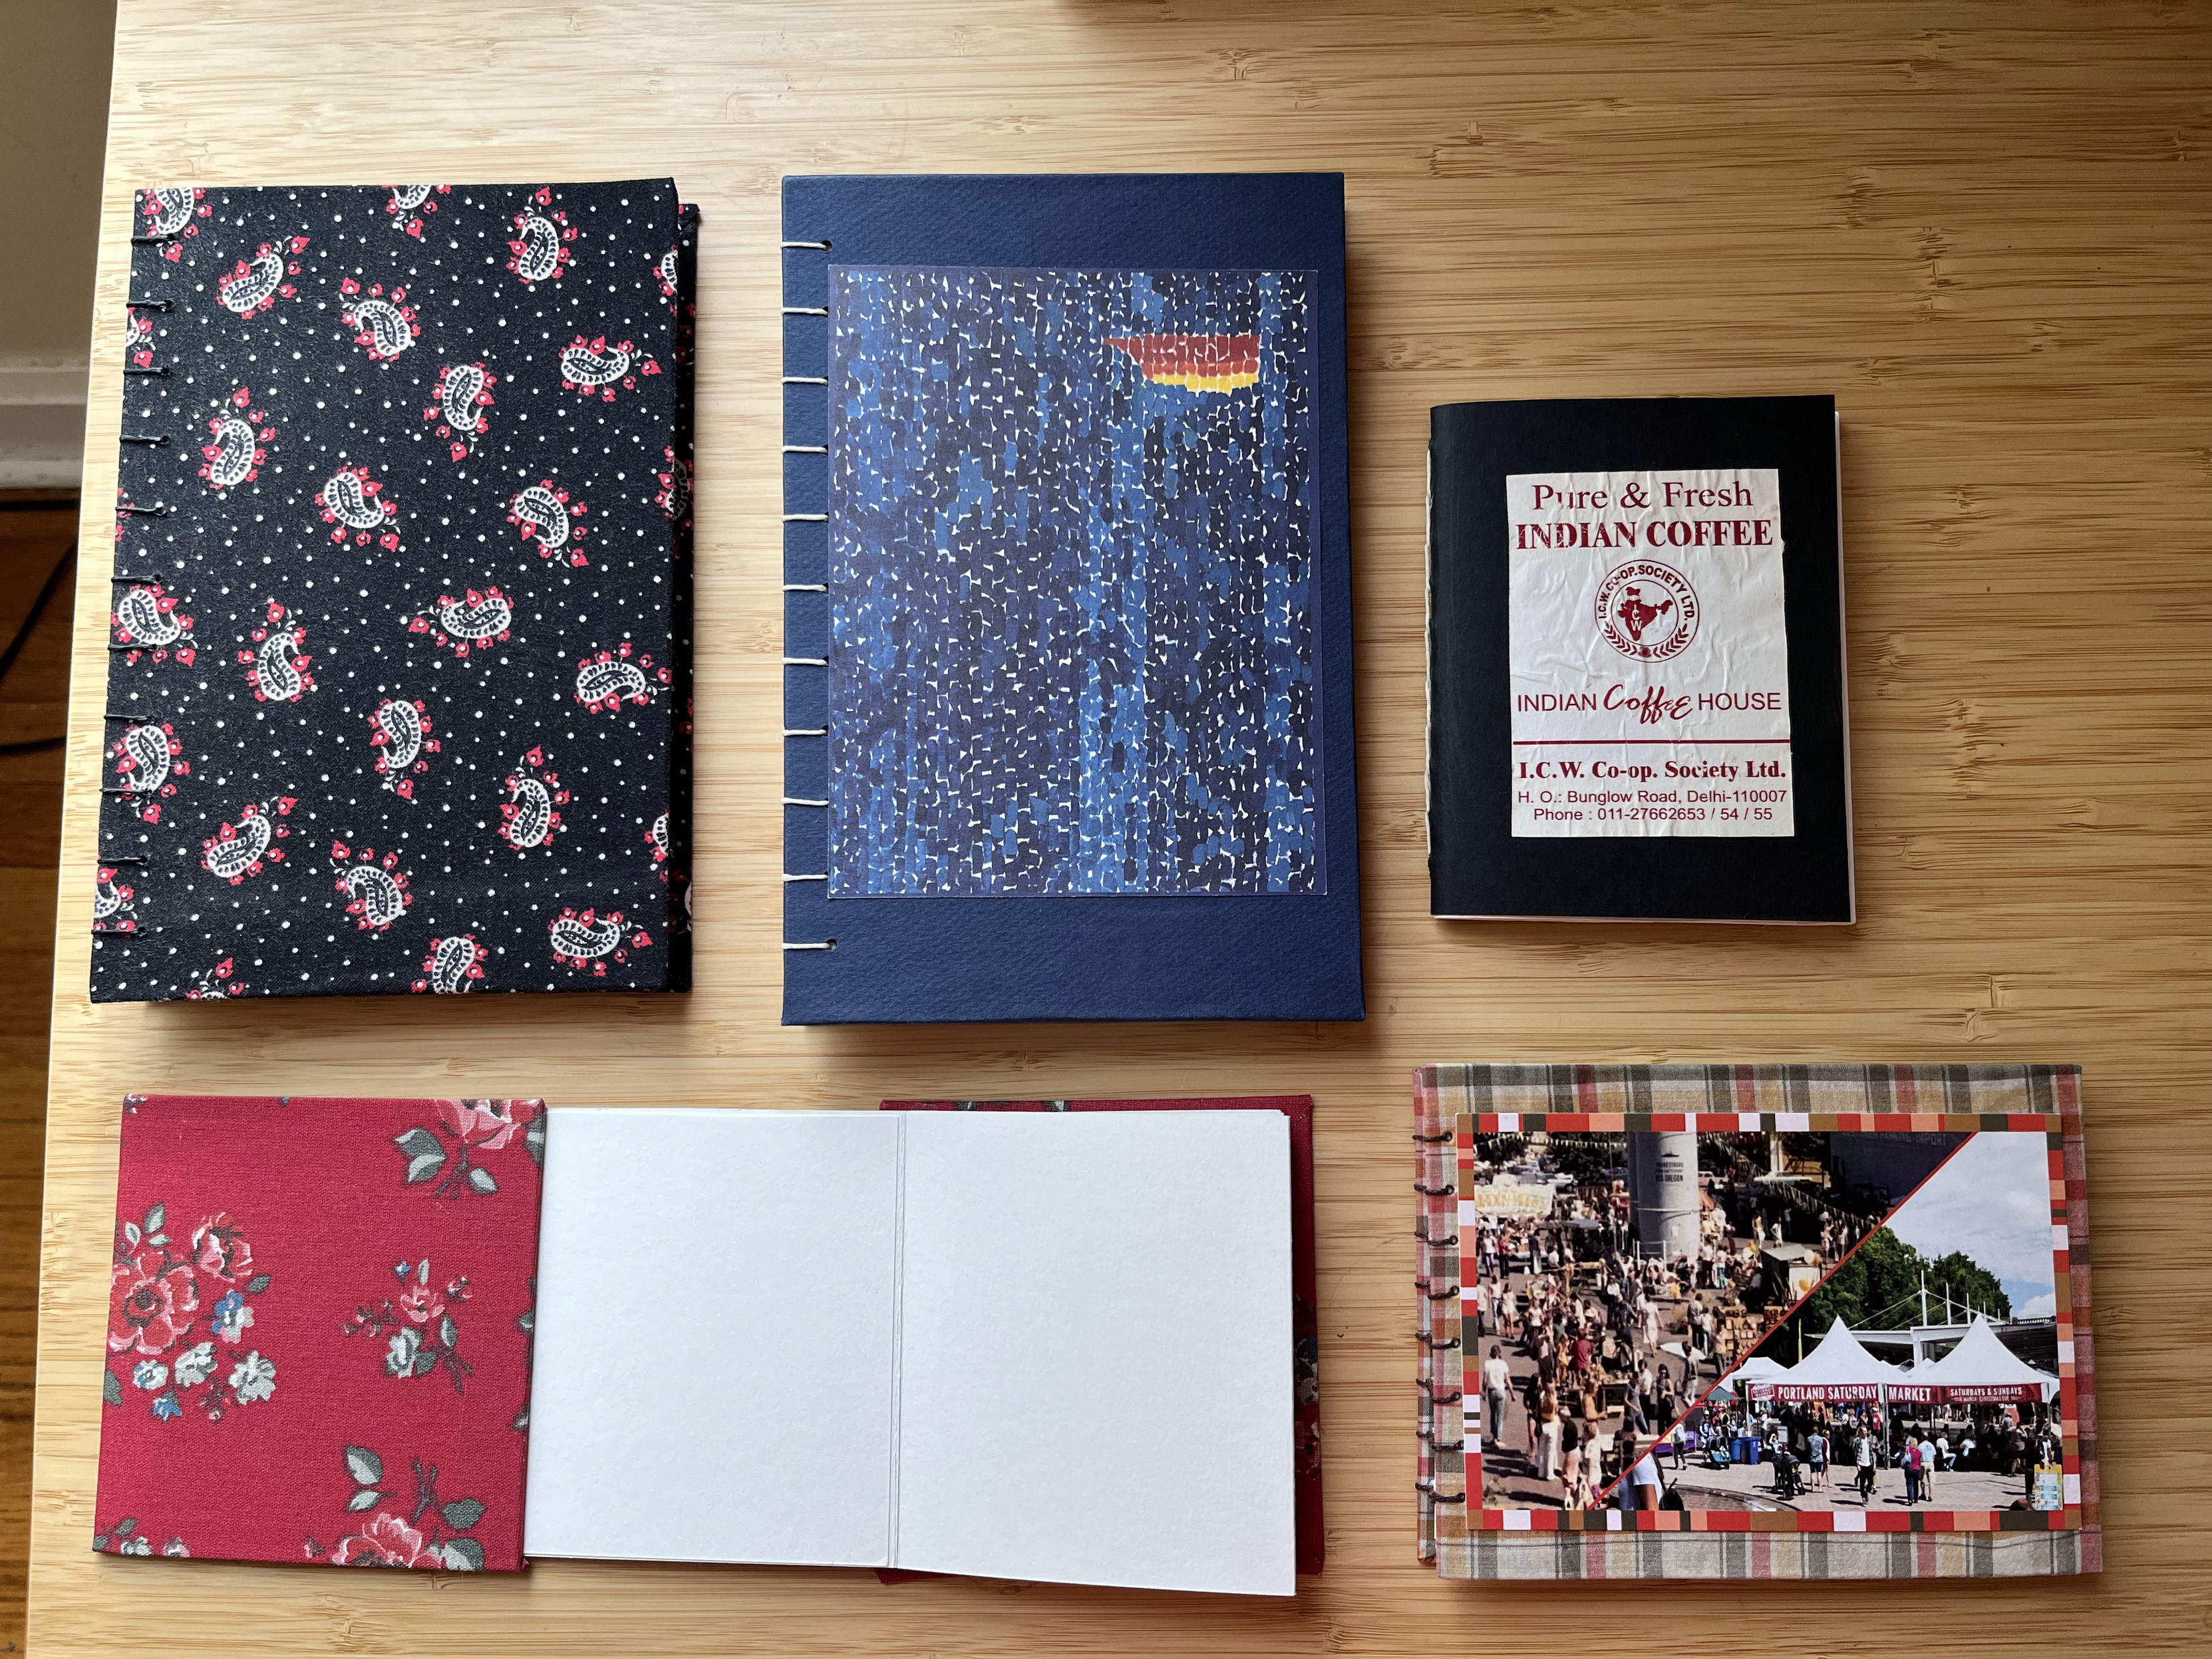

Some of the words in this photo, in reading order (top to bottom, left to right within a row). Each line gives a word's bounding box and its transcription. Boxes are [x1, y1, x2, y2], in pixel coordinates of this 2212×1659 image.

[1532, 485, 1607, 510] Pure
[1620, 482, 1650, 508] &
[1663, 481, 1753, 508] Fresh
[1516, 522, 1637, 549] INDIAN
[1647, 520, 1773, 547] COFFEE
[1680, 595, 1695, 621] LTD.
[1518, 694, 1597, 712] INDIAN
[1698, 692, 1782, 710] HOUSE
[1519, 762, 1585, 779] I.C.W.
[1592, 762, 1658, 782] Co-op.
[1665, 761, 1738, 782] Society
[1747, 760, 1786, 778] Ltd.
[1567, 791, 1633, 806] Bunglow
[1638, 790, 1682, 805] Road,
[1687, 790, 1787, 803] Delhi-110007
[1534, 809, 1583, 821] Phone
[1597, 808, 1706, 820] 011-27662653
[1720, 808, 1739, 820] 54
[1754, 808, 1773, 820] 55
[1778, 1386, 1825, 1400] PORTLAND
[1827, 1386, 1877, 1400] SATURDAY
[1888, 1386, 1931, 1402] MARKET
[1993, 1387, 2022, 1396] SUNDAYS
